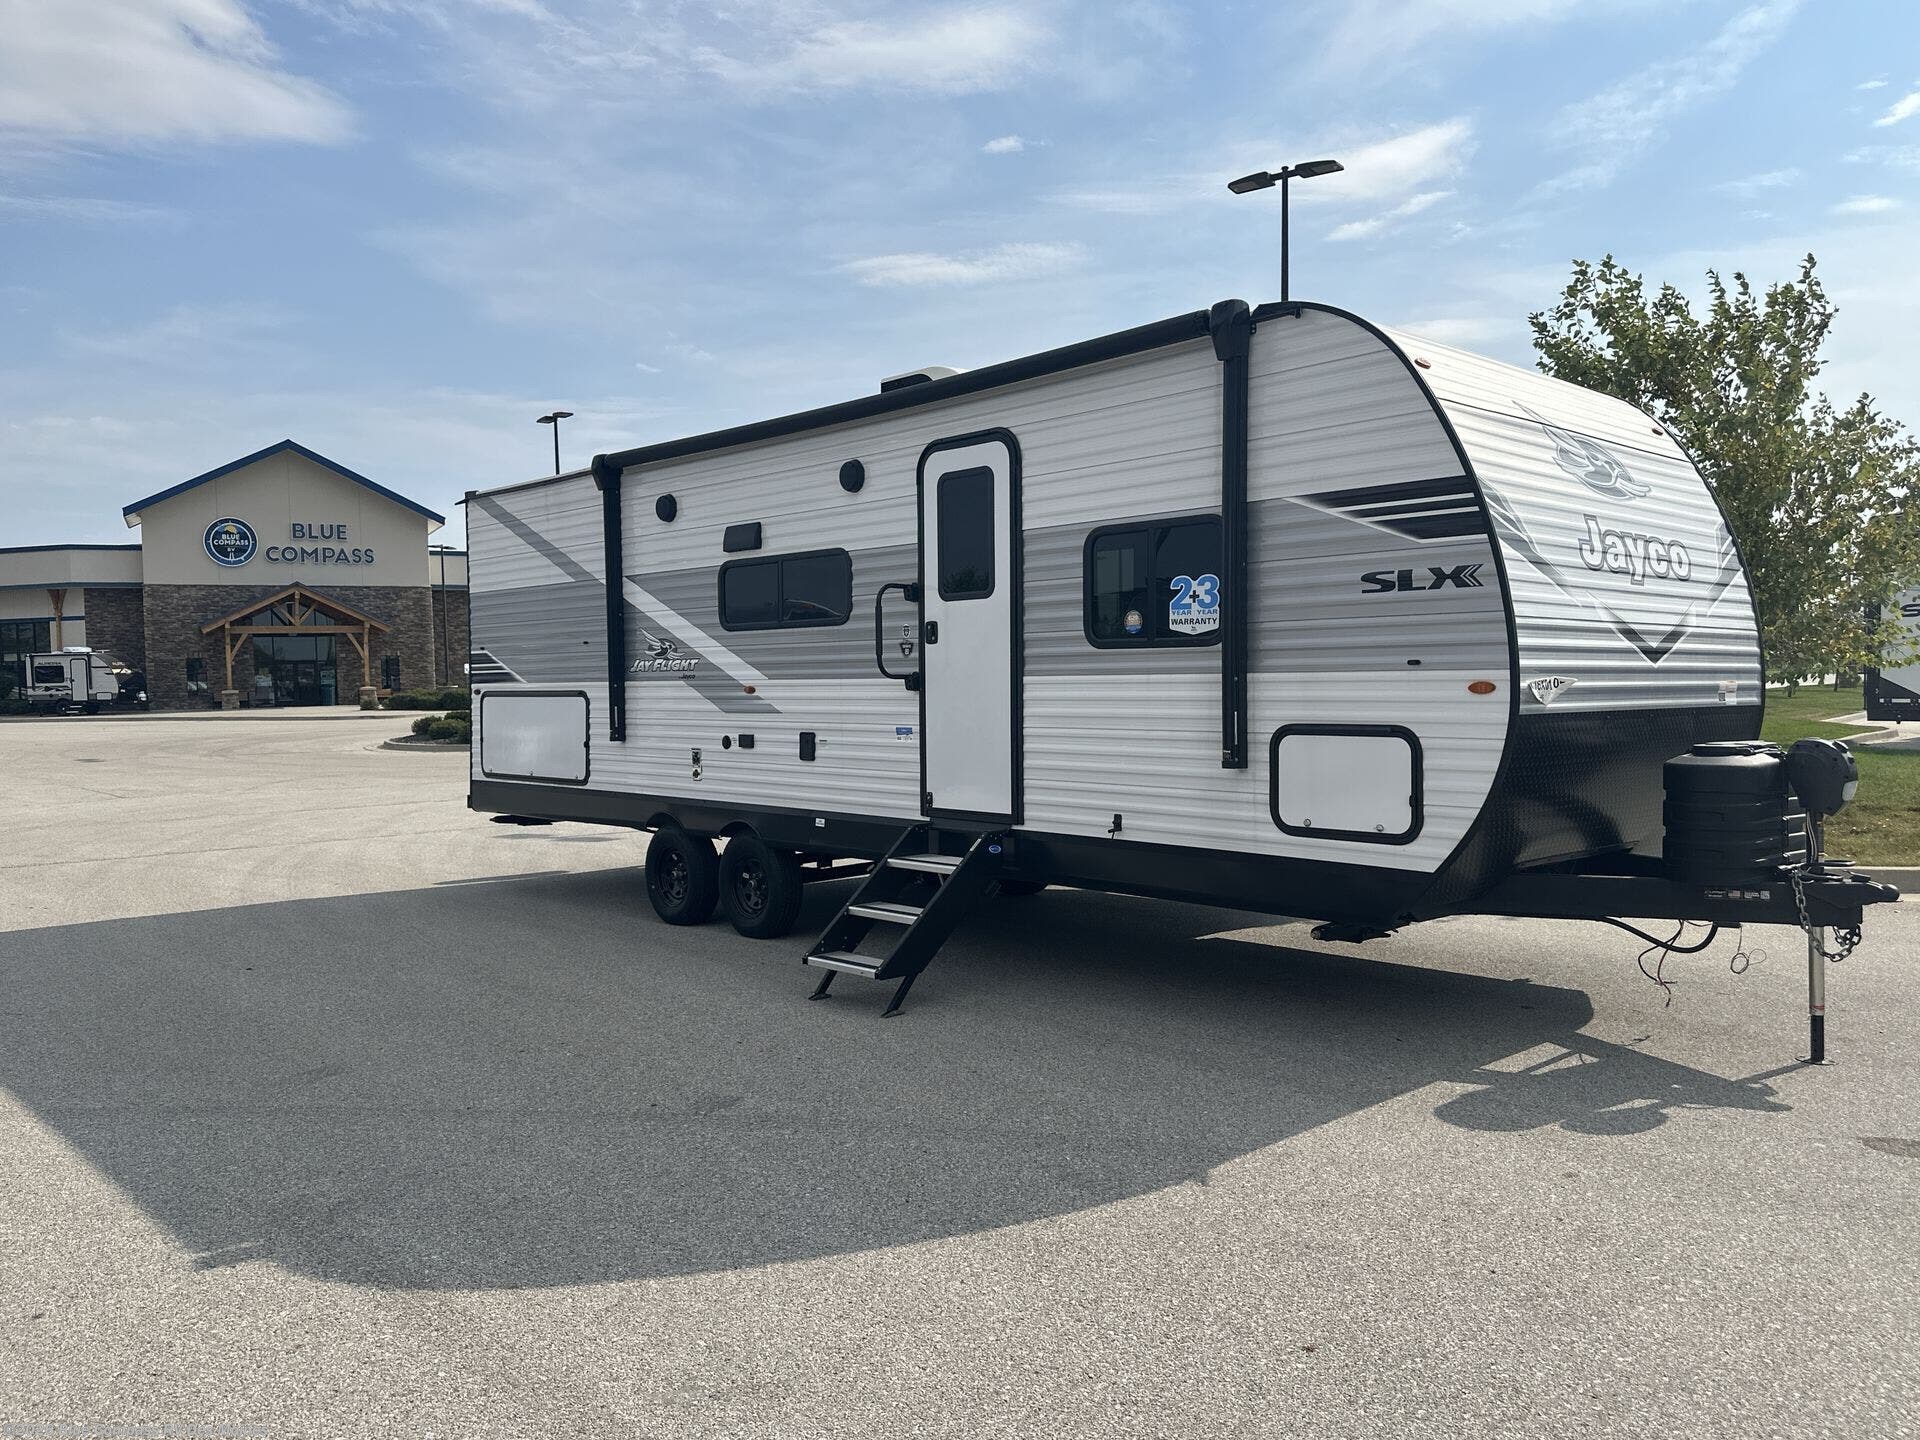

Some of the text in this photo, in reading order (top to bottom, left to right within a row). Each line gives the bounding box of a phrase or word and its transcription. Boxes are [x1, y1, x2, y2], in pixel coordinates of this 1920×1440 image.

[291, 522, 348, 541] BLUE
[265, 546, 375, 564] COMPASS
[1578, 513, 1692, 586] Jayco
[1360, 563, 1484, 594] SLX
[1171, 617, 1217, 625] WARRANTY
[630, 658, 700, 673] JAY FLIGHT
